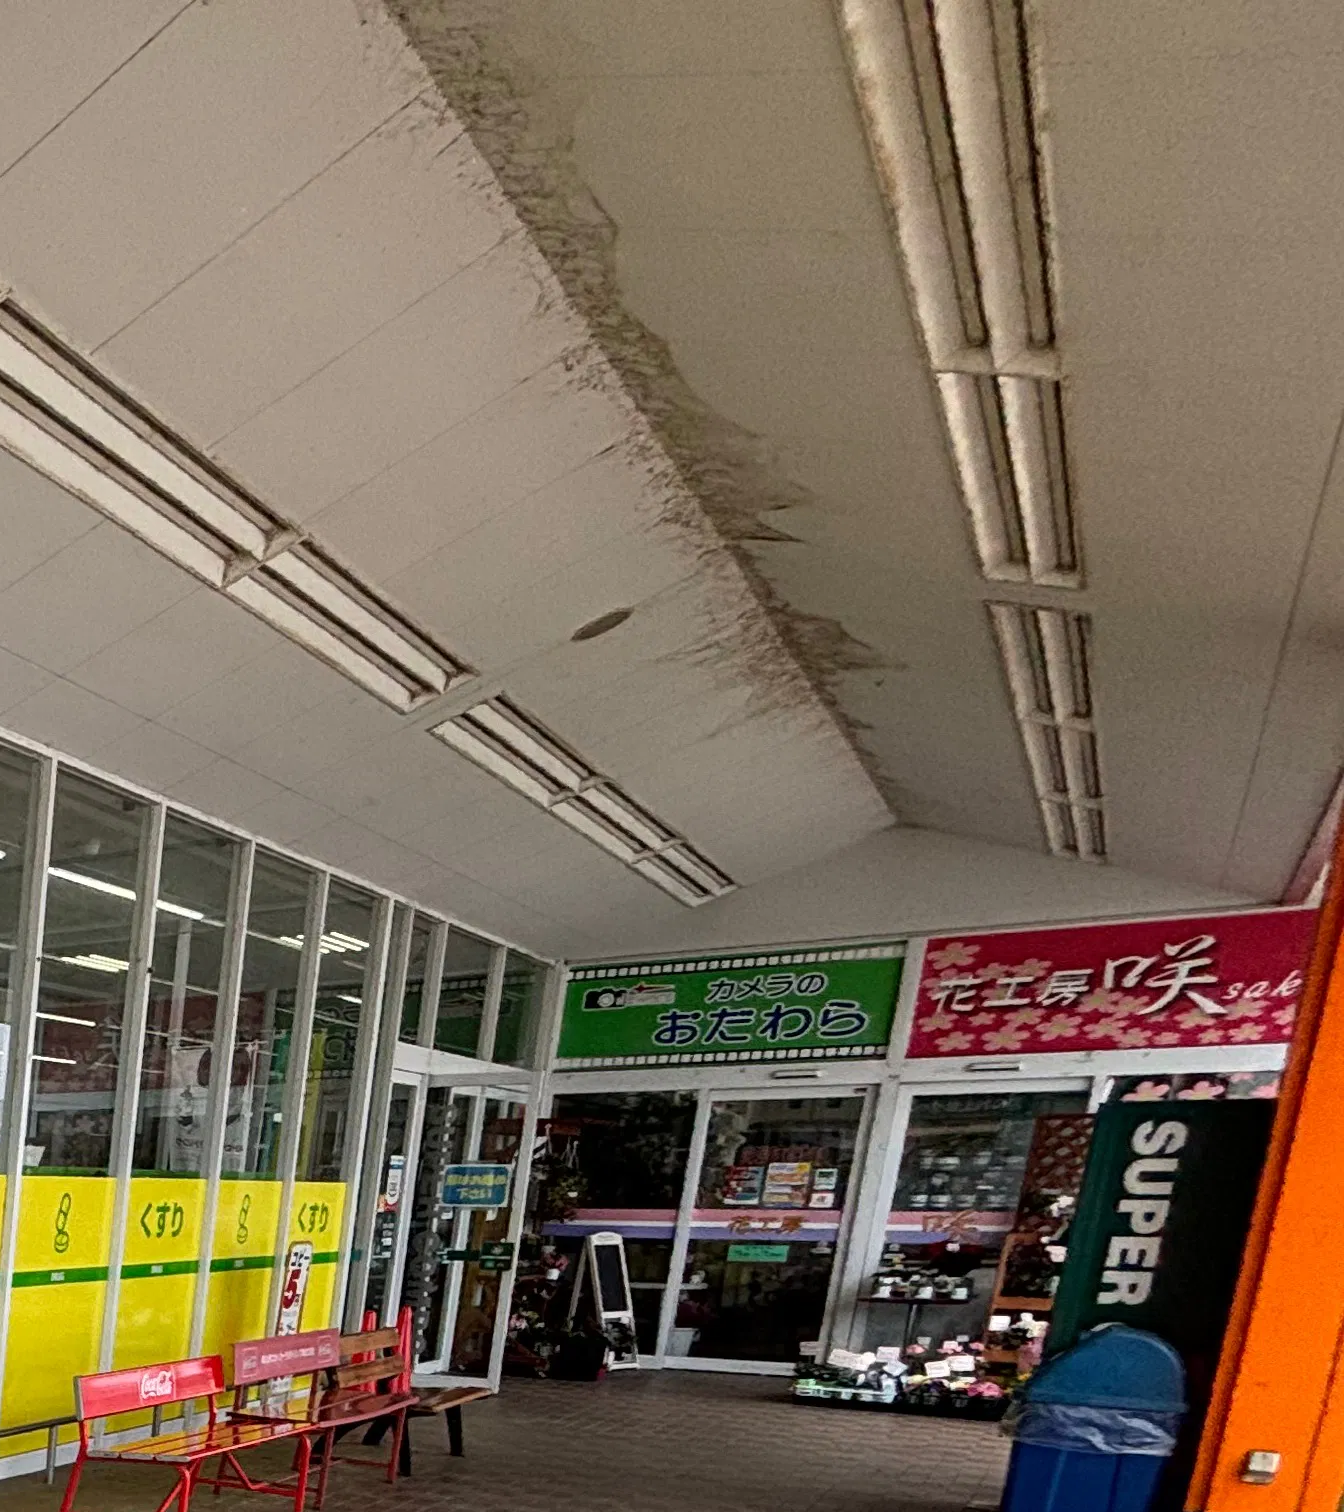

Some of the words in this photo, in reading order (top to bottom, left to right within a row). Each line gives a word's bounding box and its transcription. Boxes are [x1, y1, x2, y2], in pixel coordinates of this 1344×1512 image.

[706, 972, 827, 1002] カメラの
[931, 967, 1094, 1013] 花工房
[1221, 969, 1302, 1000] sak
[653, 1000, 868, 1046] おだわら
[140, 1202, 184, 1238] くすり
[296, 1202, 330, 1234] くすり
[1096, 1120, 1189, 1307] SUPER
